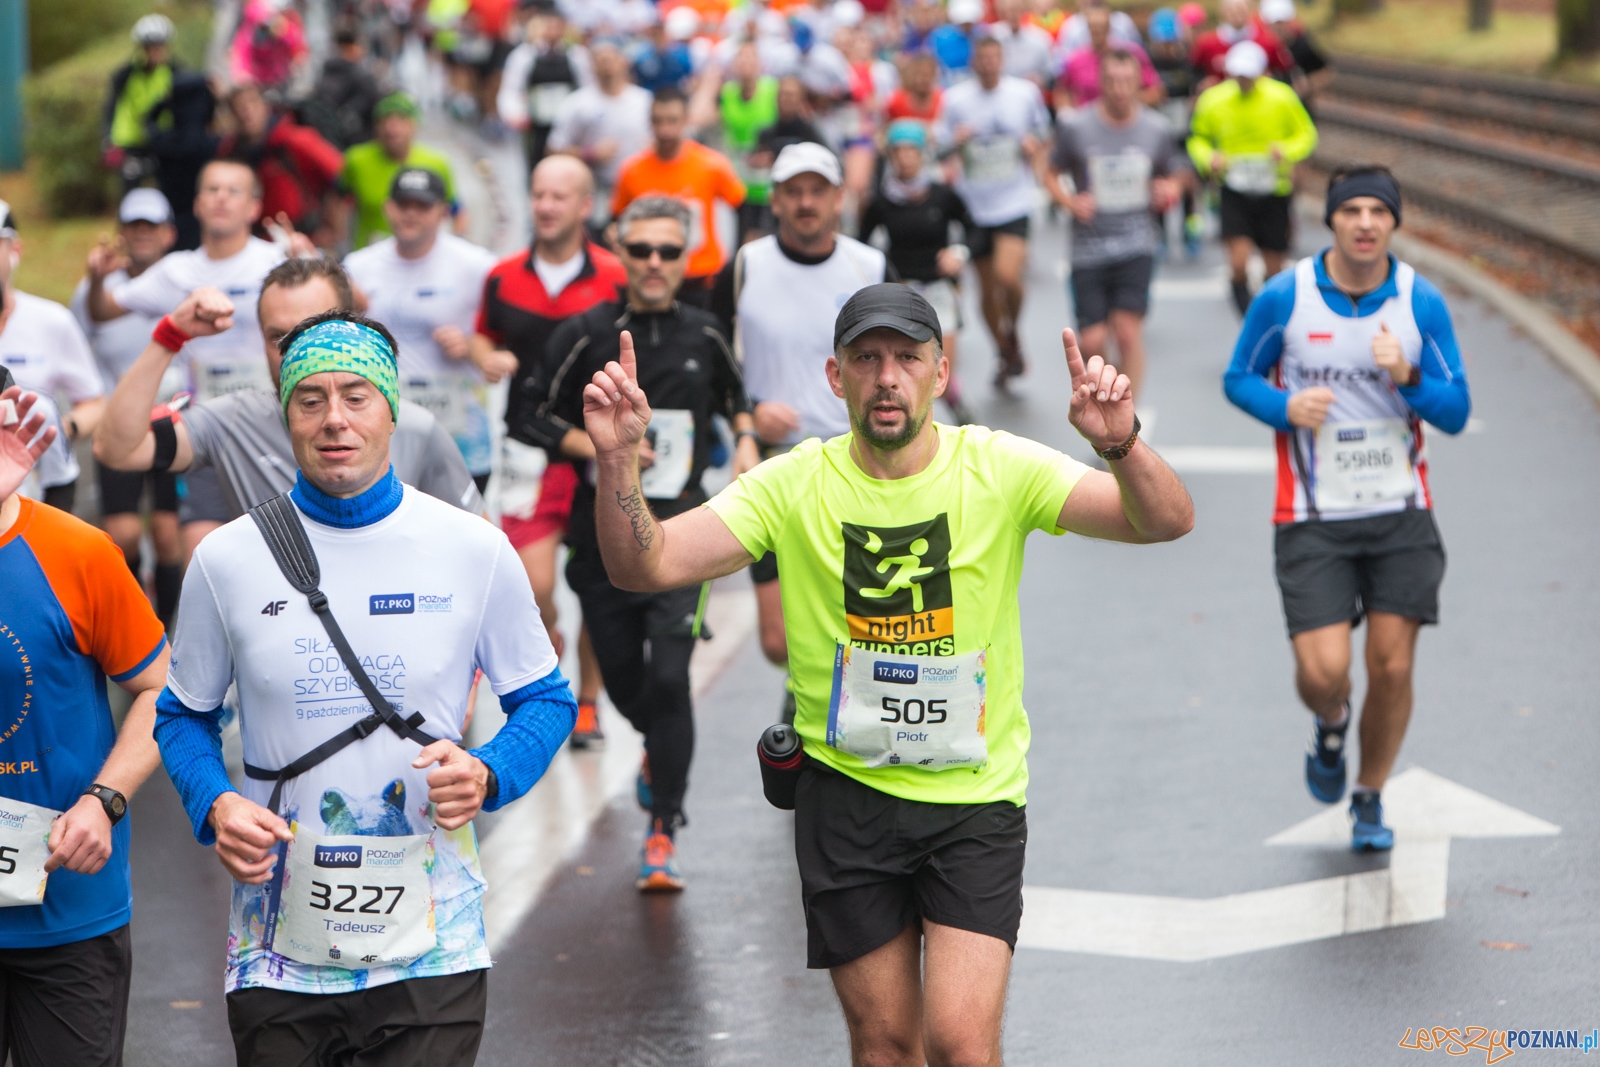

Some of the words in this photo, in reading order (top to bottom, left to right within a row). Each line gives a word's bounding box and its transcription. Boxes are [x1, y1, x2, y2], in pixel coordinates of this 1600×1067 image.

[261, 600, 288, 616] 4F
[373, 600, 388, 610] 17.
[388, 599, 412, 609] PKO
[418, 602, 452, 610] maraton
[868, 613, 936, 642] night
[0, 622, 33, 686] ZYTYWNIE
[877, 667, 891, 677] 17.
[892, 669, 915, 679] PKO
[296, 708, 304, 719] 9
[880, 696, 948, 725] 505
[896, 731, 929, 742] Piotr
[318, 851, 333, 862] 17.
[334, 851, 358, 862] PKO
[366, 857, 404, 866] maraton
[309, 880, 405, 915] 3227
[323, 919, 386, 934] Tadeusz
[360, 954, 378, 963] 4F
